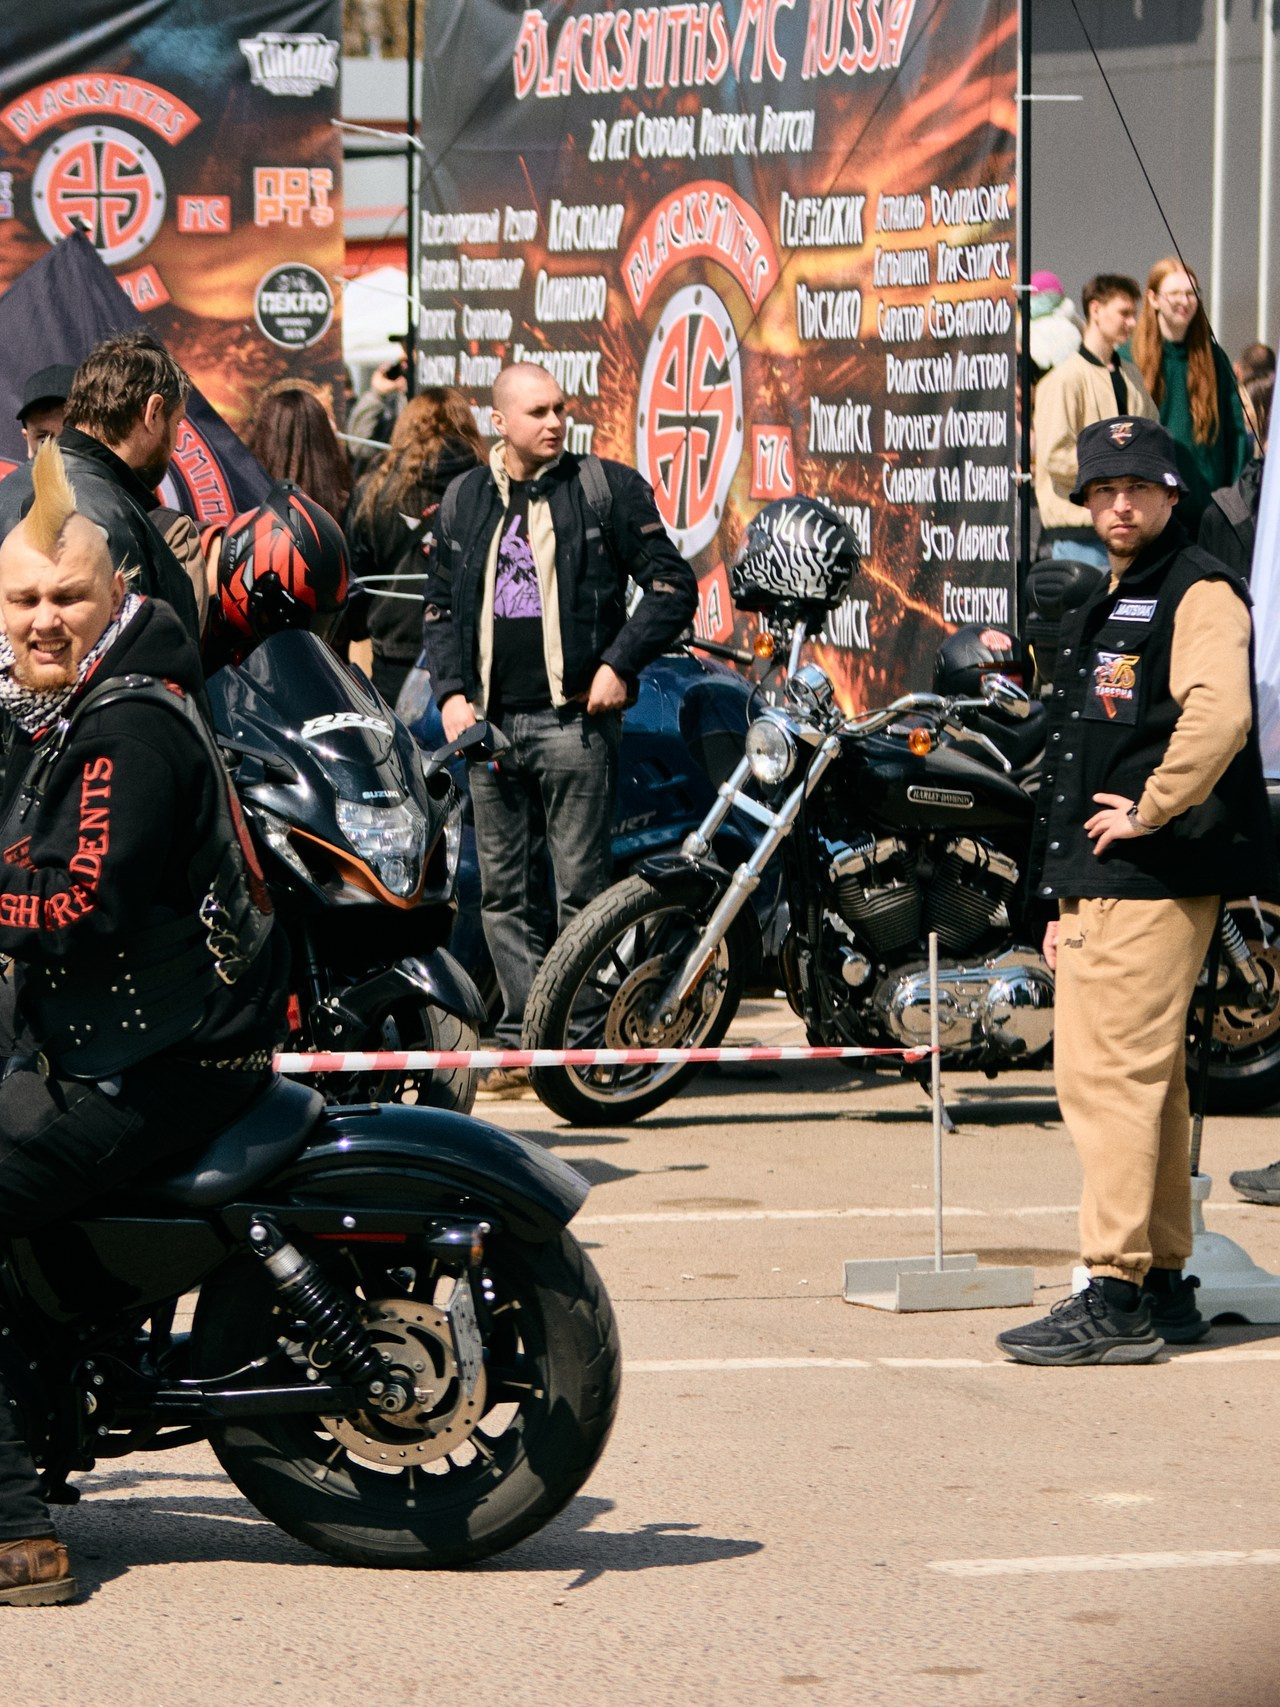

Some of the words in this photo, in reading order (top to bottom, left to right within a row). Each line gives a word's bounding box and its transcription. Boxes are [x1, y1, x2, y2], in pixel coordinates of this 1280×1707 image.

[514, 1, 730, 100] BLACKSMITHS
[732, 0, 795, 82] MC
[8, 77, 187, 138] BLACKSMITHS
[184, 199, 226, 229] MC
[628, 190, 769, 307] BLACKSMITHS
[797, 282, 862, 340] МЫСХАКО
[877, 298, 926, 343] САРАТОВ
[808, 395, 872, 453] МОЖАЙСК
[944, 406, 1008, 448] ЛЮБЕРЦЫ
[756, 433, 793, 492] MC
[939, 465, 961, 502] НА
[964, 459, 1009, 502] КУБАНИ
[920, 520, 955, 562] УСТЬ
[957, 520, 1010, 562] ЛАБИНСК
[943, 581, 1008, 624] ЕССЕНТУКИ
[362, 790, 400, 800] SUZUKI
